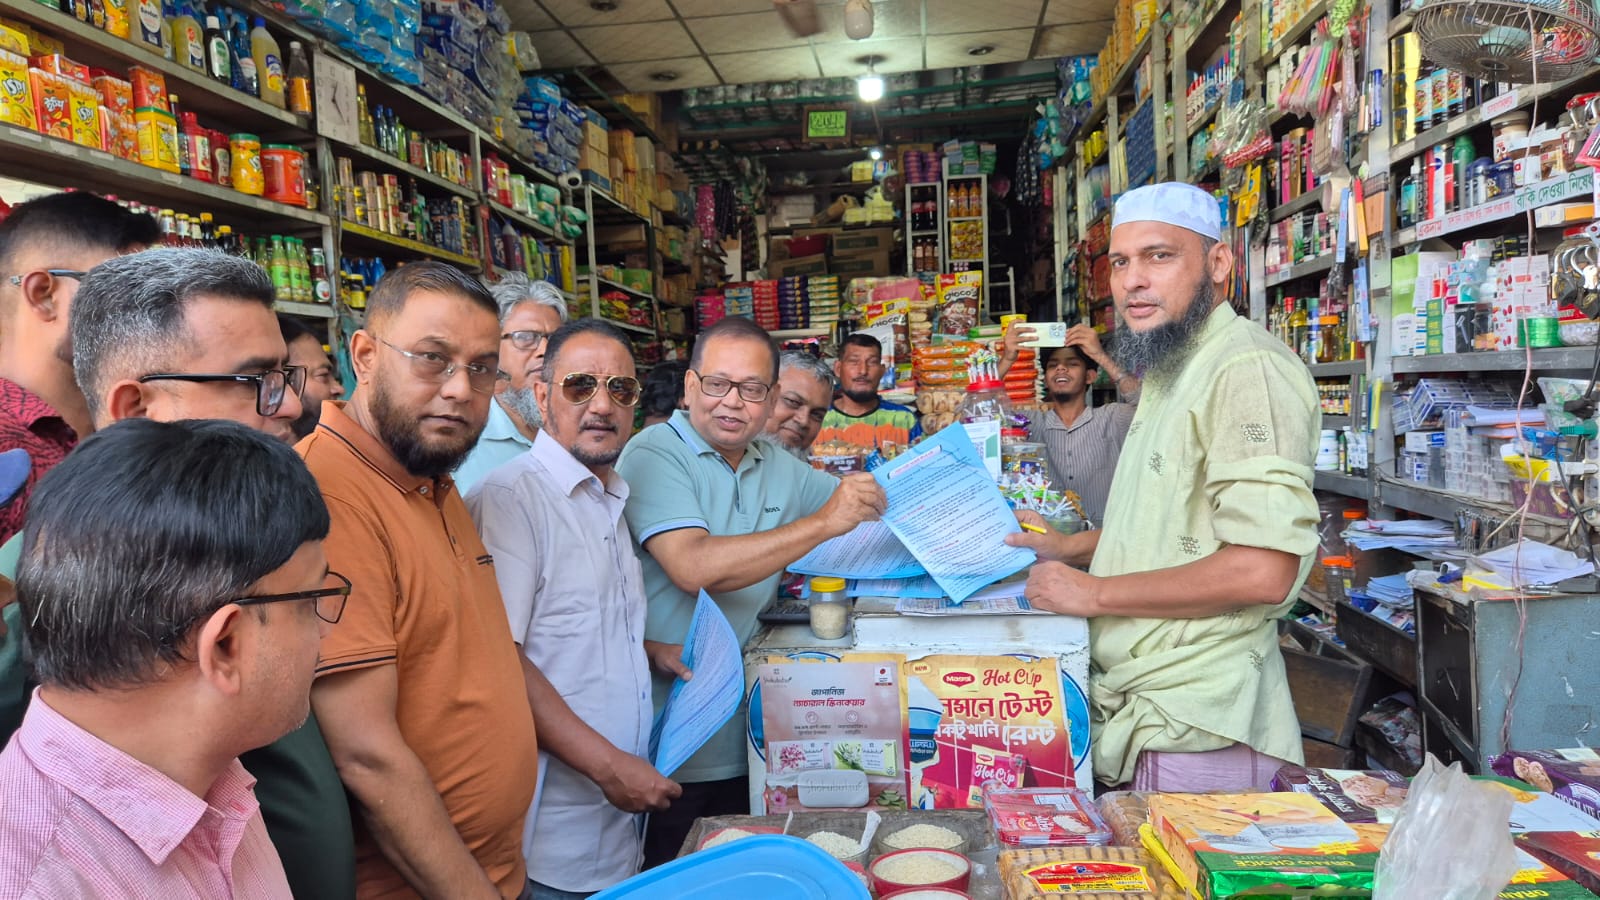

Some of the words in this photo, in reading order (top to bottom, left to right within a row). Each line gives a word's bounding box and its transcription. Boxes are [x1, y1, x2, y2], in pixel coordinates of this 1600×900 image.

[1515, 185, 1536, 209] বাকি
[1538, 180, 1566, 202] দেওয়া
[983, 669, 1011, 686] Hot
[998, 690, 1055, 721] টেস্ট
[1003, 722, 1058, 748] রেস্ট
[974, 764, 995, 779] Hot
